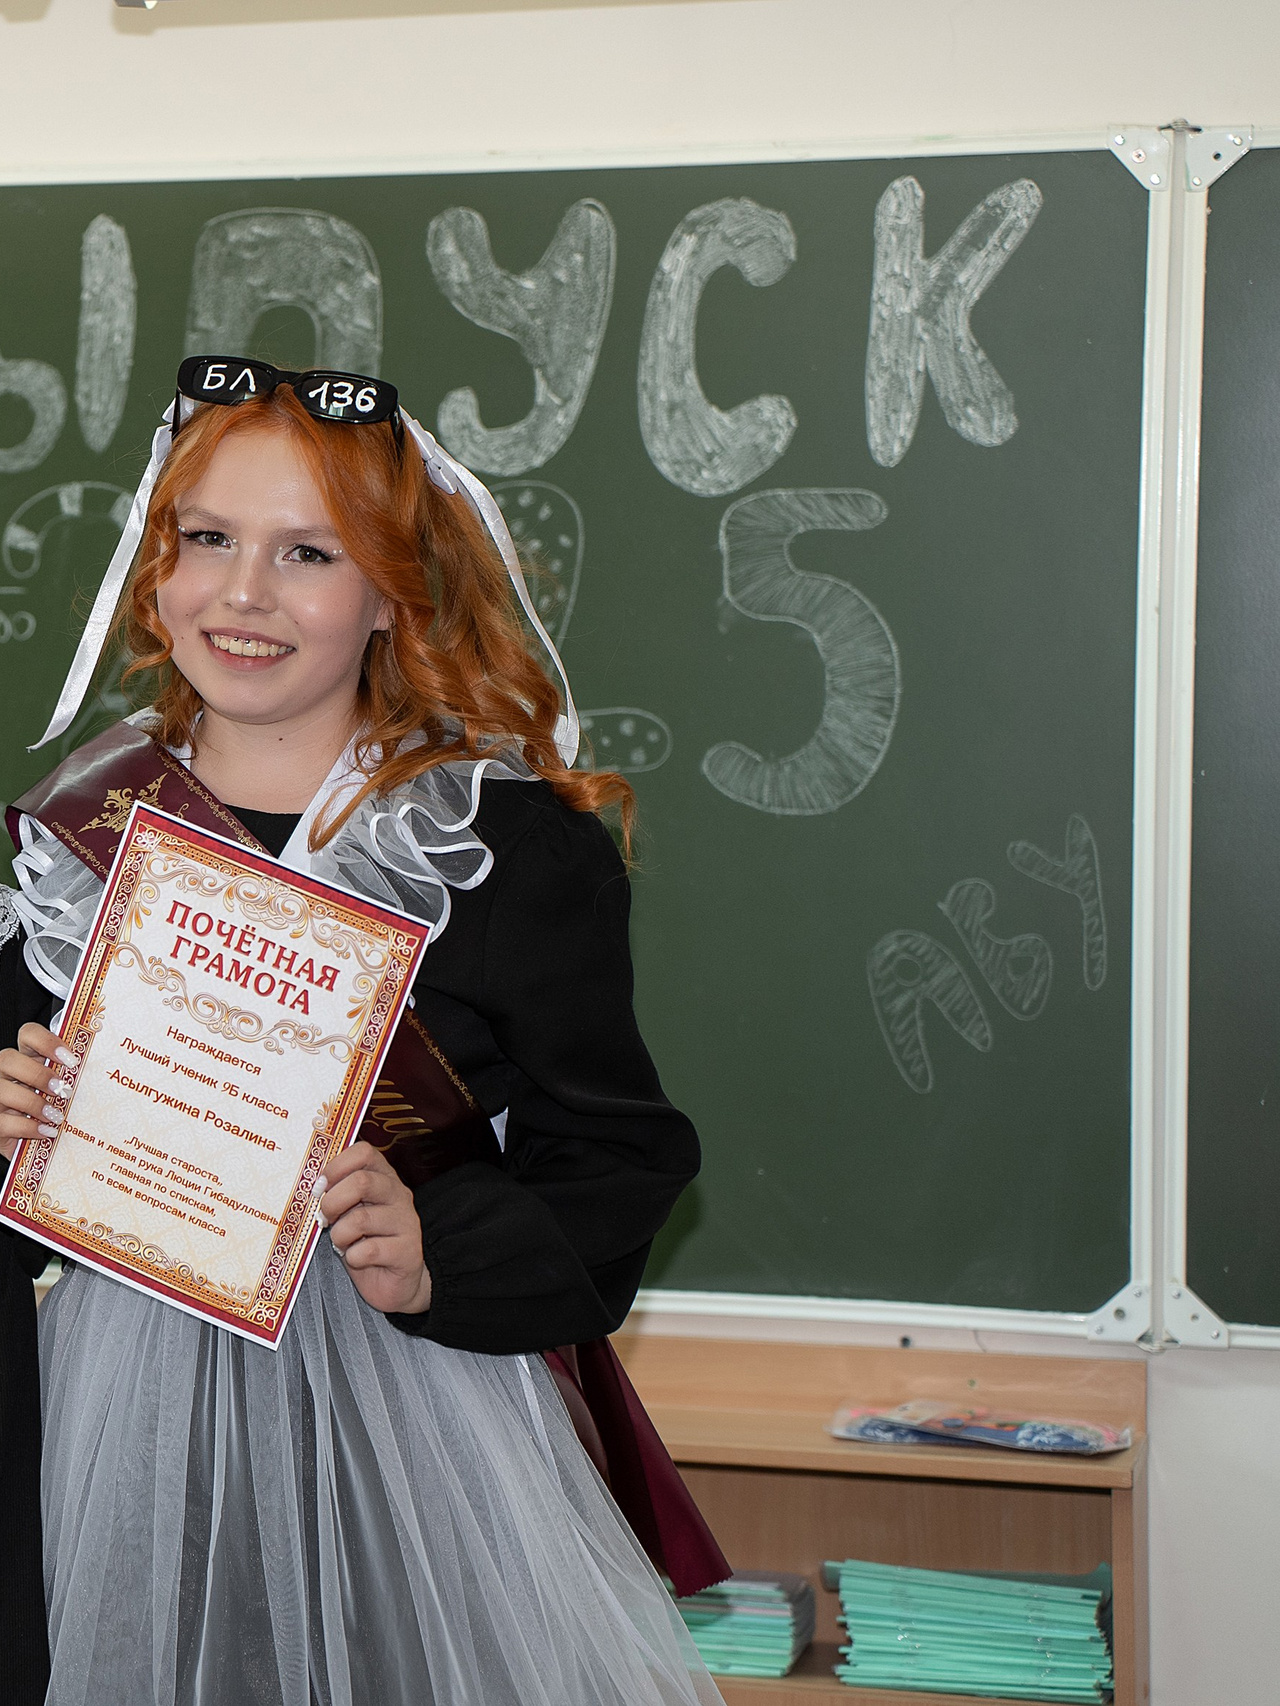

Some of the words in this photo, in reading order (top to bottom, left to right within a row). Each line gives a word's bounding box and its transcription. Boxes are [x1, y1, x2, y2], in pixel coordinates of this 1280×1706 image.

[308, 380, 378, 413] 136
[165, 900, 341, 992] ПОЧЁТНАЯ
[169, 934, 310, 1015] ГРАМОТА
[120, 1037, 171, 1067] Лучший
[171, 1061, 219, 1089] ученик
[220, 1081, 240, 1098] 9Б
[241, 1092, 290, 1119] класса
[166, 1025, 262, 1076] Награждается
[97, 1139, 105, 1149] и
[106, 1144, 137, 1163] левая
[138, 1157, 164, 1176] рука
[165, 1169, 202, 1193] Люции
[110, 1161, 153, 1187] главная
[153, 1181, 167, 1194] по
[169, 1189, 217, 1218] спискам,
[91, 1169, 105, 1182] по
[106, 1178, 133, 1196] всем
[134, 1190, 187, 1221] вопросам
[188, 1214, 227, 1238] класса
